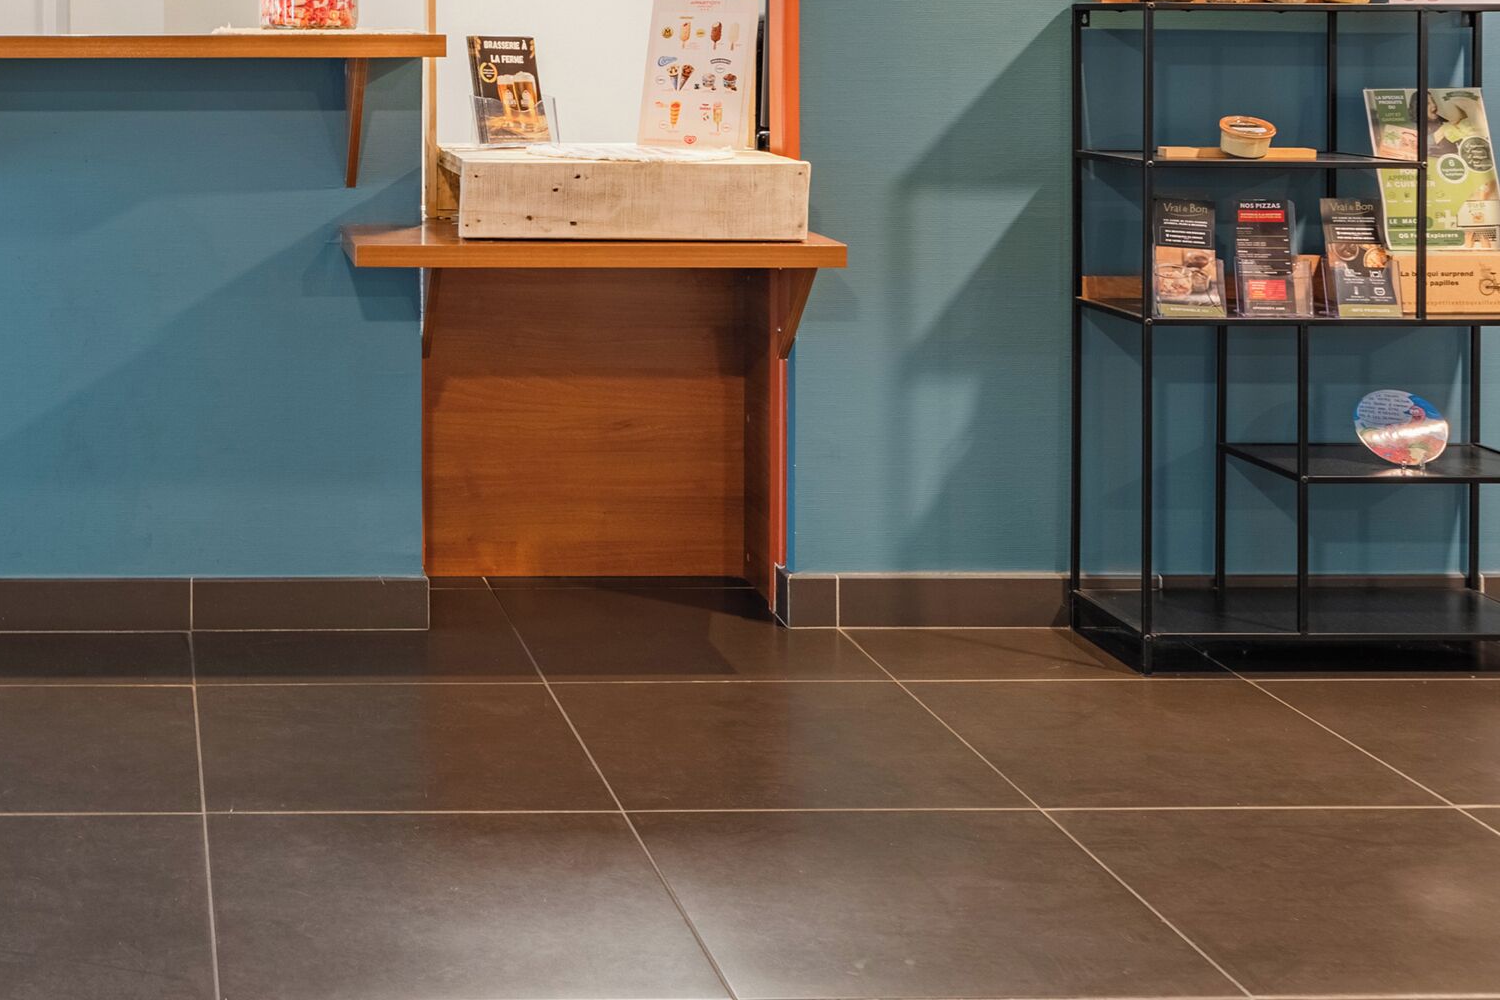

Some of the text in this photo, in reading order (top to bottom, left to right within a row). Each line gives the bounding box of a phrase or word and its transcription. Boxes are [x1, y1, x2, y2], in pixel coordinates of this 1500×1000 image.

[483, 39, 528, 51] BRASSERIE À
[490, 54, 524, 64] LA FERME
[1163, 202, 1182, 213] Vrai
[1189, 203, 1208, 214] Bon
[1355, 201, 1374, 211] Bon
